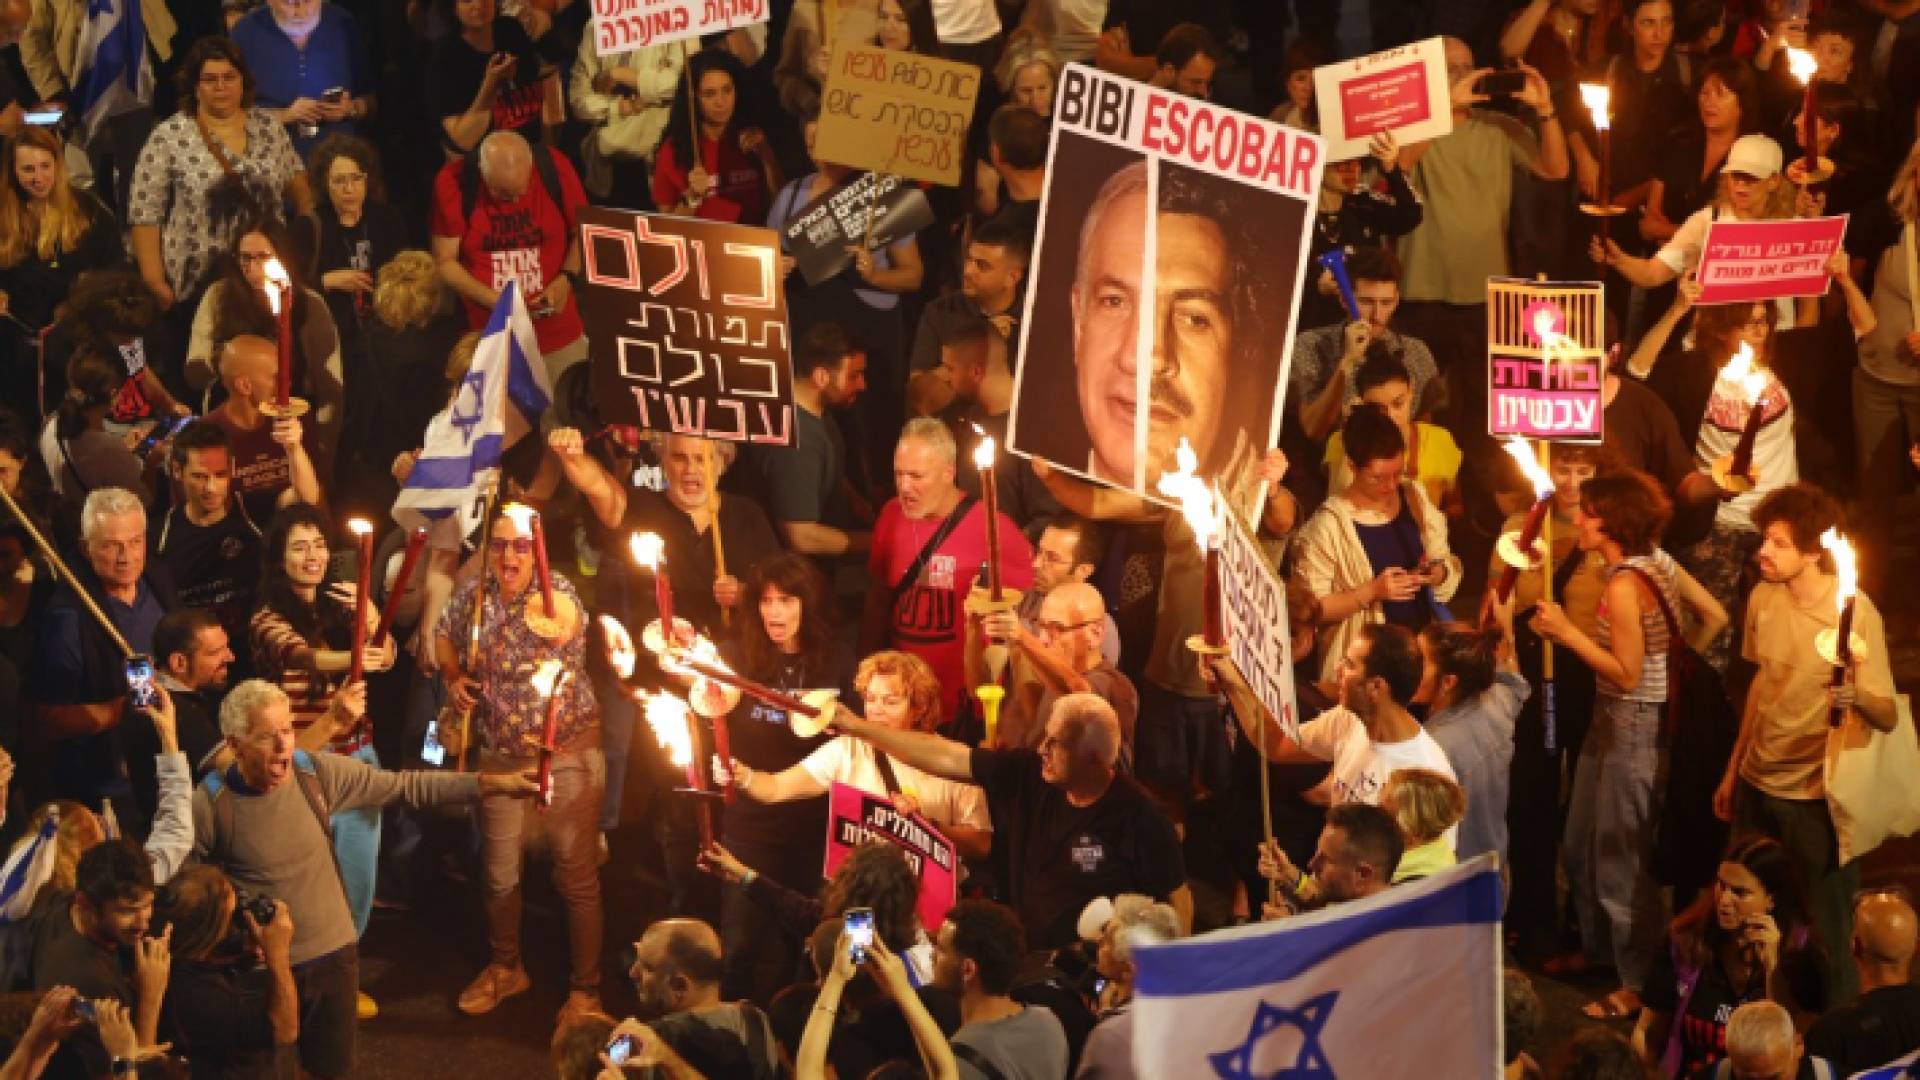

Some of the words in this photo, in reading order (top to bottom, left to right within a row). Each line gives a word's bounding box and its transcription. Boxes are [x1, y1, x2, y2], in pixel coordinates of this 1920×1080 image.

[600, 5, 689, 49] במנהרה
[827, 88, 863, 119] אש
[1060, 69, 1135, 140] BIBI
[1141, 94, 1320, 194] ESCOBAR
[581, 216, 777, 309] כולם
[616, 335, 779, 398] כולם
[630, 386, 792, 446] עכשיו
[1498, 393, 1597, 430] עכשיו!
